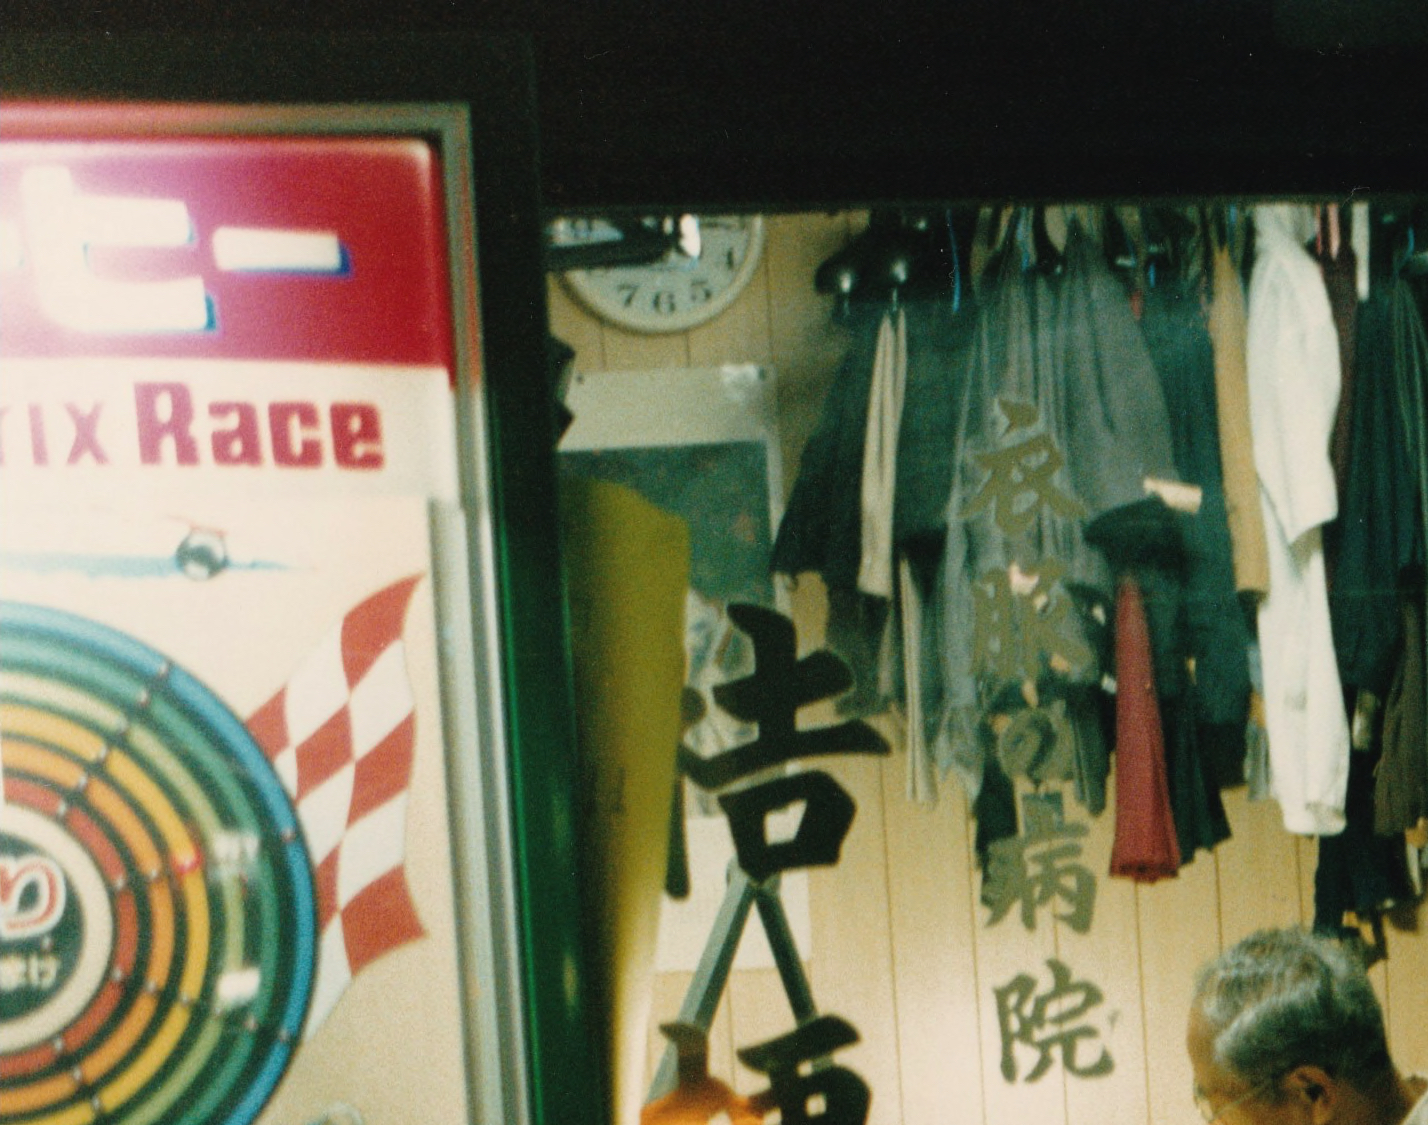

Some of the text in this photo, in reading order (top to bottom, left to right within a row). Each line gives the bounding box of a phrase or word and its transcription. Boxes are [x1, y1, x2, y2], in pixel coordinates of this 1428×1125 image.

[0, 165, 351, 336] ヒー
[652, 289, 676, 316] 6
[0, 382, 386, 470] ix Race
[952, 398, 1116, 1085] 衣服の病院
